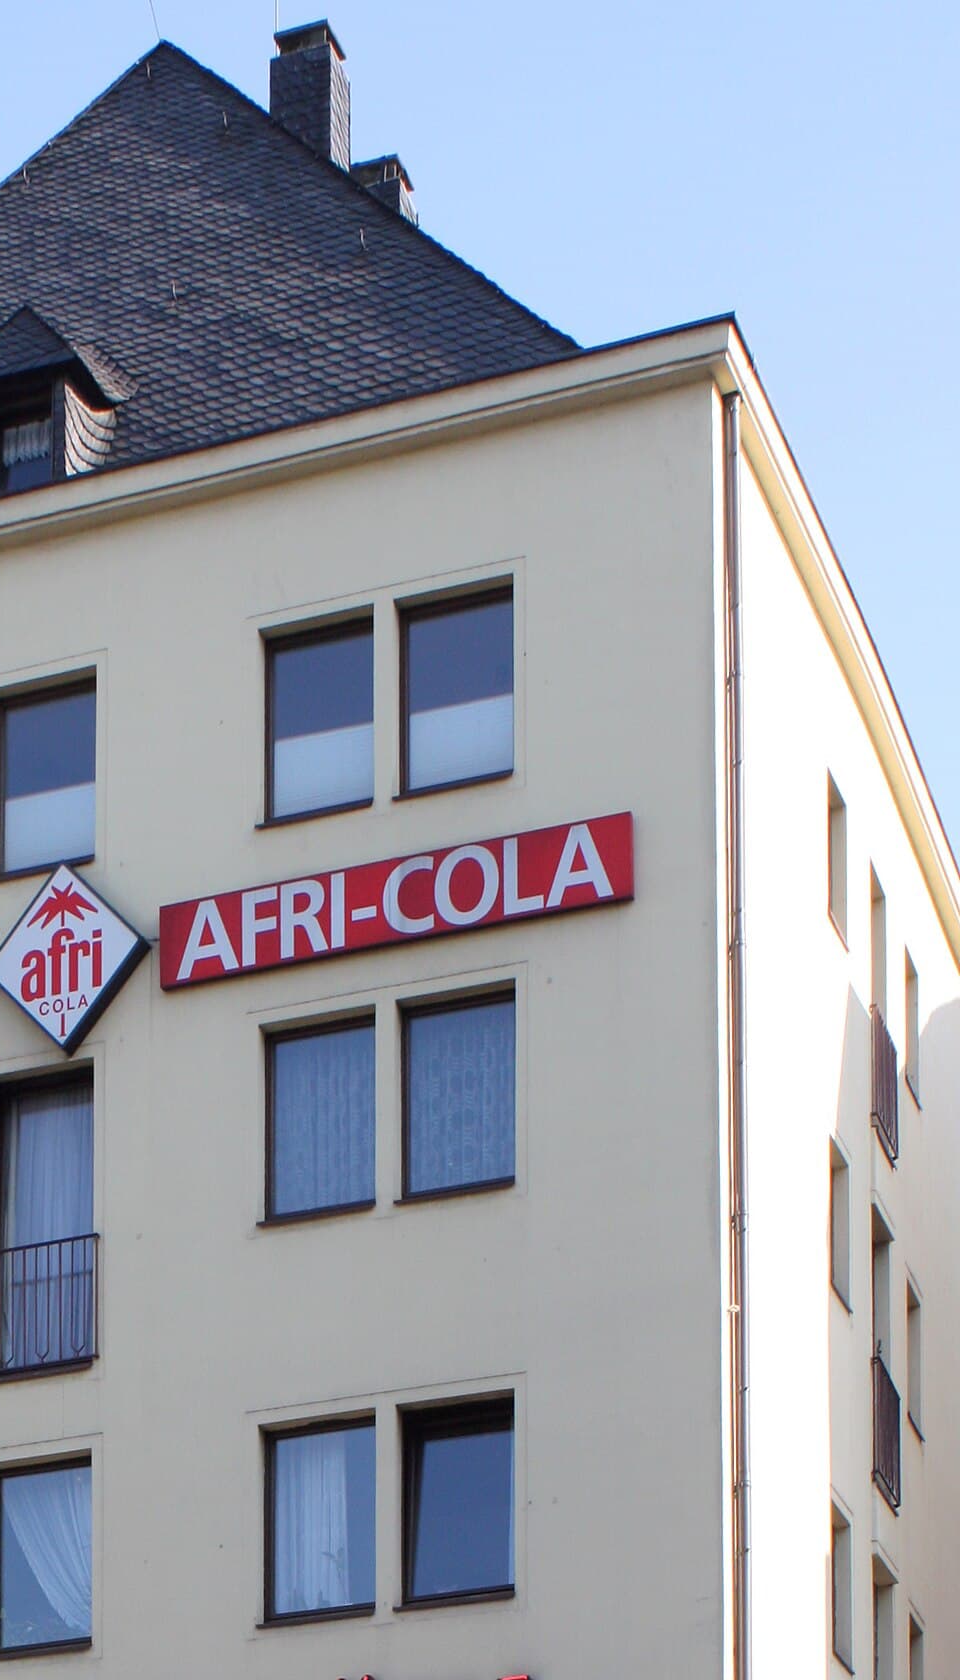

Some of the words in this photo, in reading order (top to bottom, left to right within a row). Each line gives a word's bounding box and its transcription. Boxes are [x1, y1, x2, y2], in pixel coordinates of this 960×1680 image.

[176, 824, 615, 981] AFRI-COLA
[20, 928, 103, 1003] afri
[39, 994, 89, 1016] COLA
